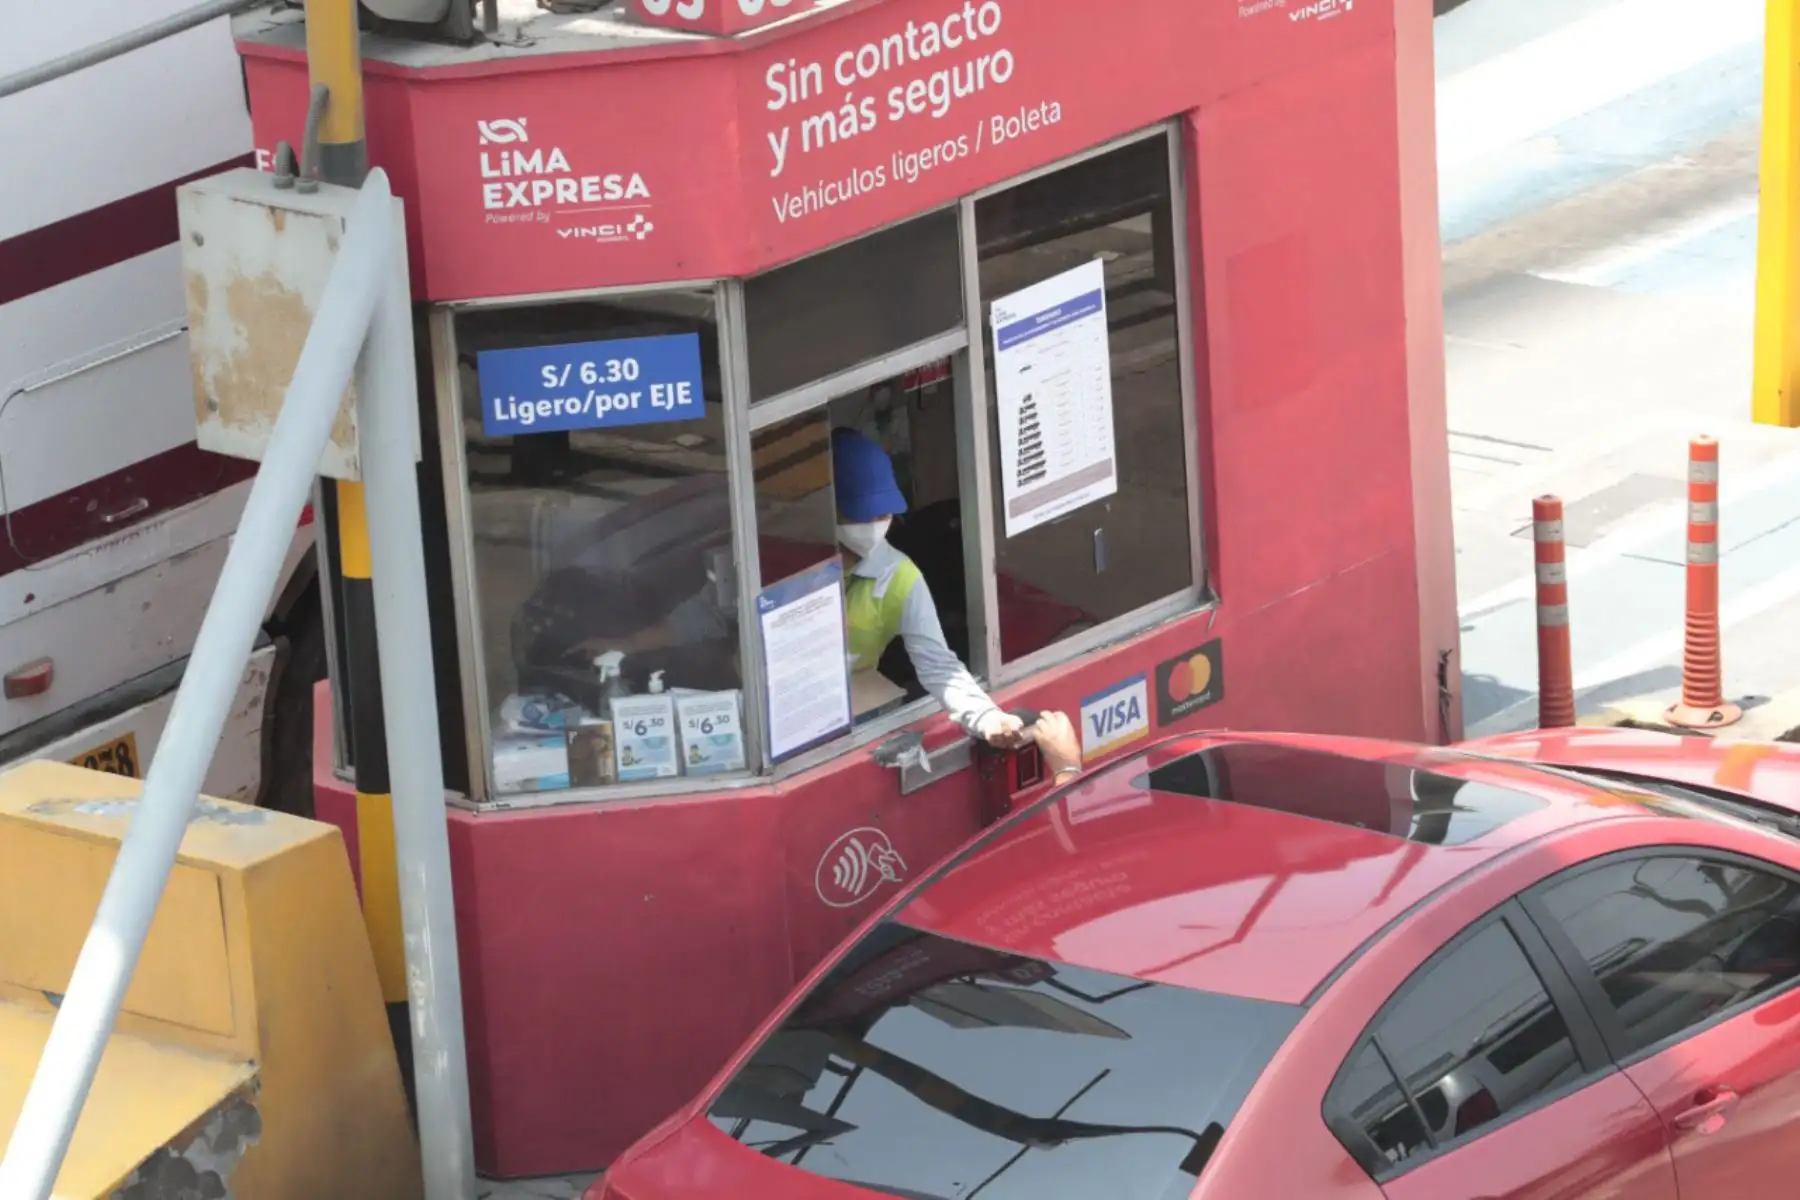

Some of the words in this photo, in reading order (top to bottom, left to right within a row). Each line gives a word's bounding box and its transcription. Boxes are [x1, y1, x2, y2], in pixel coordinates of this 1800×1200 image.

[765, 57, 823, 111] Sin
[834, 0, 1002, 86] contacto
[766, 125, 790, 177] y
[801, 91, 878, 153] más
[887, 48, 1015, 119] seguro
[771, 163, 886, 224] Vehículos
[891, 132, 968, 184] ligeros
[990, 100, 1062, 147] Boleta
[483, 172, 650, 209] EXPRESA
[485, 210, 534, 225] Powered
[536, 210, 551, 224] by
[556, 223, 622, 239] VINCI
[541, 363, 572, 388] S/
[579, 357, 640, 386] 6.30
[493, 389, 642, 425] Ligero/por
[650, 380, 693, 411] EJE
[1089, 695, 1141, 737] VISA
